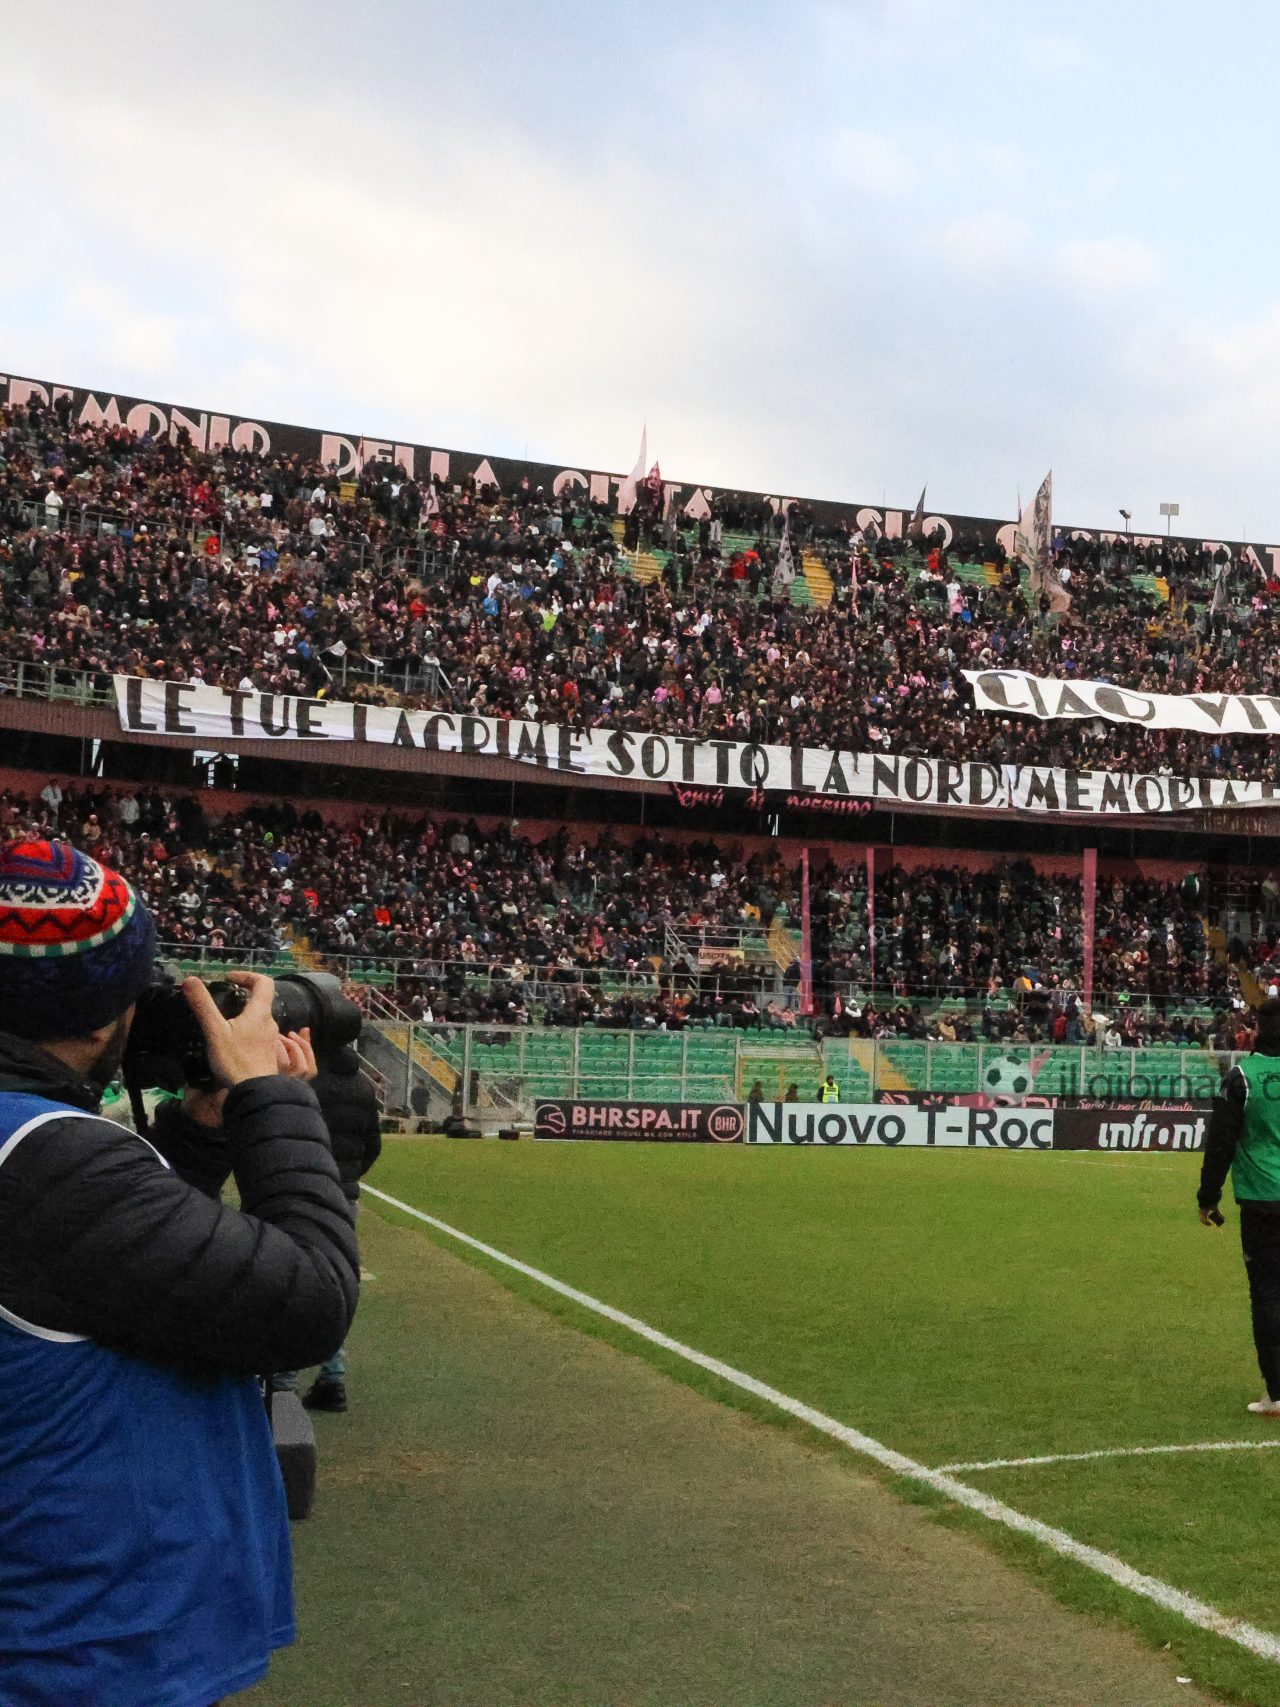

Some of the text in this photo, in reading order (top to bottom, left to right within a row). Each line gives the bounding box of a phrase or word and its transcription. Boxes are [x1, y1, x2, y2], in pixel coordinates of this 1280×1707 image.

[976, 671, 1156, 722] CIAO
[127, 678, 196, 734] LE
[222, 688, 329, 738] TUE
[606, 730, 770, 787] SOTTO
[791, 746, 850, 794] LA
[572, 1106, 702, 1129] BHRSPA.IT
[714, 1116, 736, 1131] BHR
[749, 1102, 1054, 1149] Nuovo T-Roc
[1098, 1113, 1206, 1149] infront
